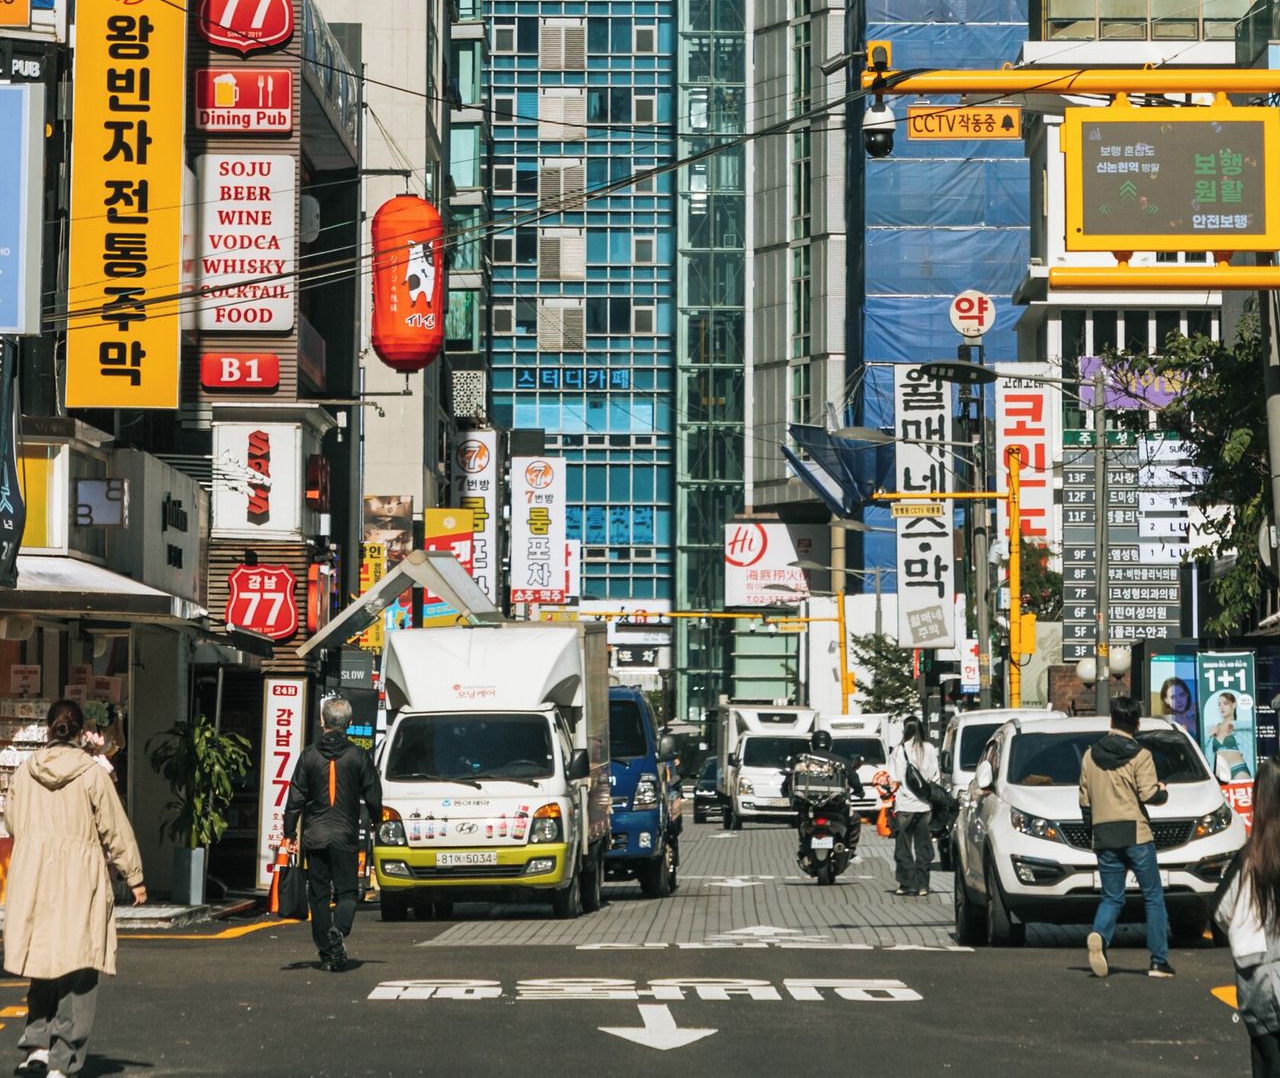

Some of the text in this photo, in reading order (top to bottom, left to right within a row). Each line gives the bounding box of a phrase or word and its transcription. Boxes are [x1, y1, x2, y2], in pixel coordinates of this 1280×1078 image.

[227, 31, 247, 39] SINCE
[10, 59, 40, 78] PUB
[199, 110, 287, 129] Dining Pub
[1101, 146, 1120, 156] 보행
[218, 162, 272, 177] SOJU
[1097, 162, 1139, 173] 신논현역
[1195, 152, 1243, 175] 보행
[219, 186, 272, 201] BEER
[1195, 180, 1244, 203] 원활
[99, 15, 156, 387] 왕빈자 전통주막
[218, 210, 272, 225] WINE
[1193, 214, 1248, 229] 안전보행
[209, 234, 280, 250] VODCA
[201, 258, 287, 275] WHISKY
[199, 283, 289, 300] COCKTAIL
[214, 307, 273, 323] FOOD
[954, 297, 988, 327] 약
[220, 357, 263, 382] B1
[456, 475, 490, 491] 7번방
[1068, 474, 1086, 483] 13F
[525, 491, 553, 504] 7번방
[1068, 492, 1086, 501] 12F
[1068, 511, 1086, 521] 11F
[1074, 550, 1086, 559] 9F
[1074, 569, 1086, 578] 8F
[248, 575, 277, 589] 강남
[1075, 589, 1086, 598] 7F
[239, 592, 285, 626] 77
[1074, 608, 1086, 617] 6F
[1075, 627, 1086, 636] 5F
[1075, 646, 1086, 656] 3F
[341, 670, 365, 679] SLOW
[1204, 669, 1246, 692] 1+1
[275, 686, 296, 695] 24H
[276, 708, 293, 747] 강남
[272, 751, 291, 807] 77
